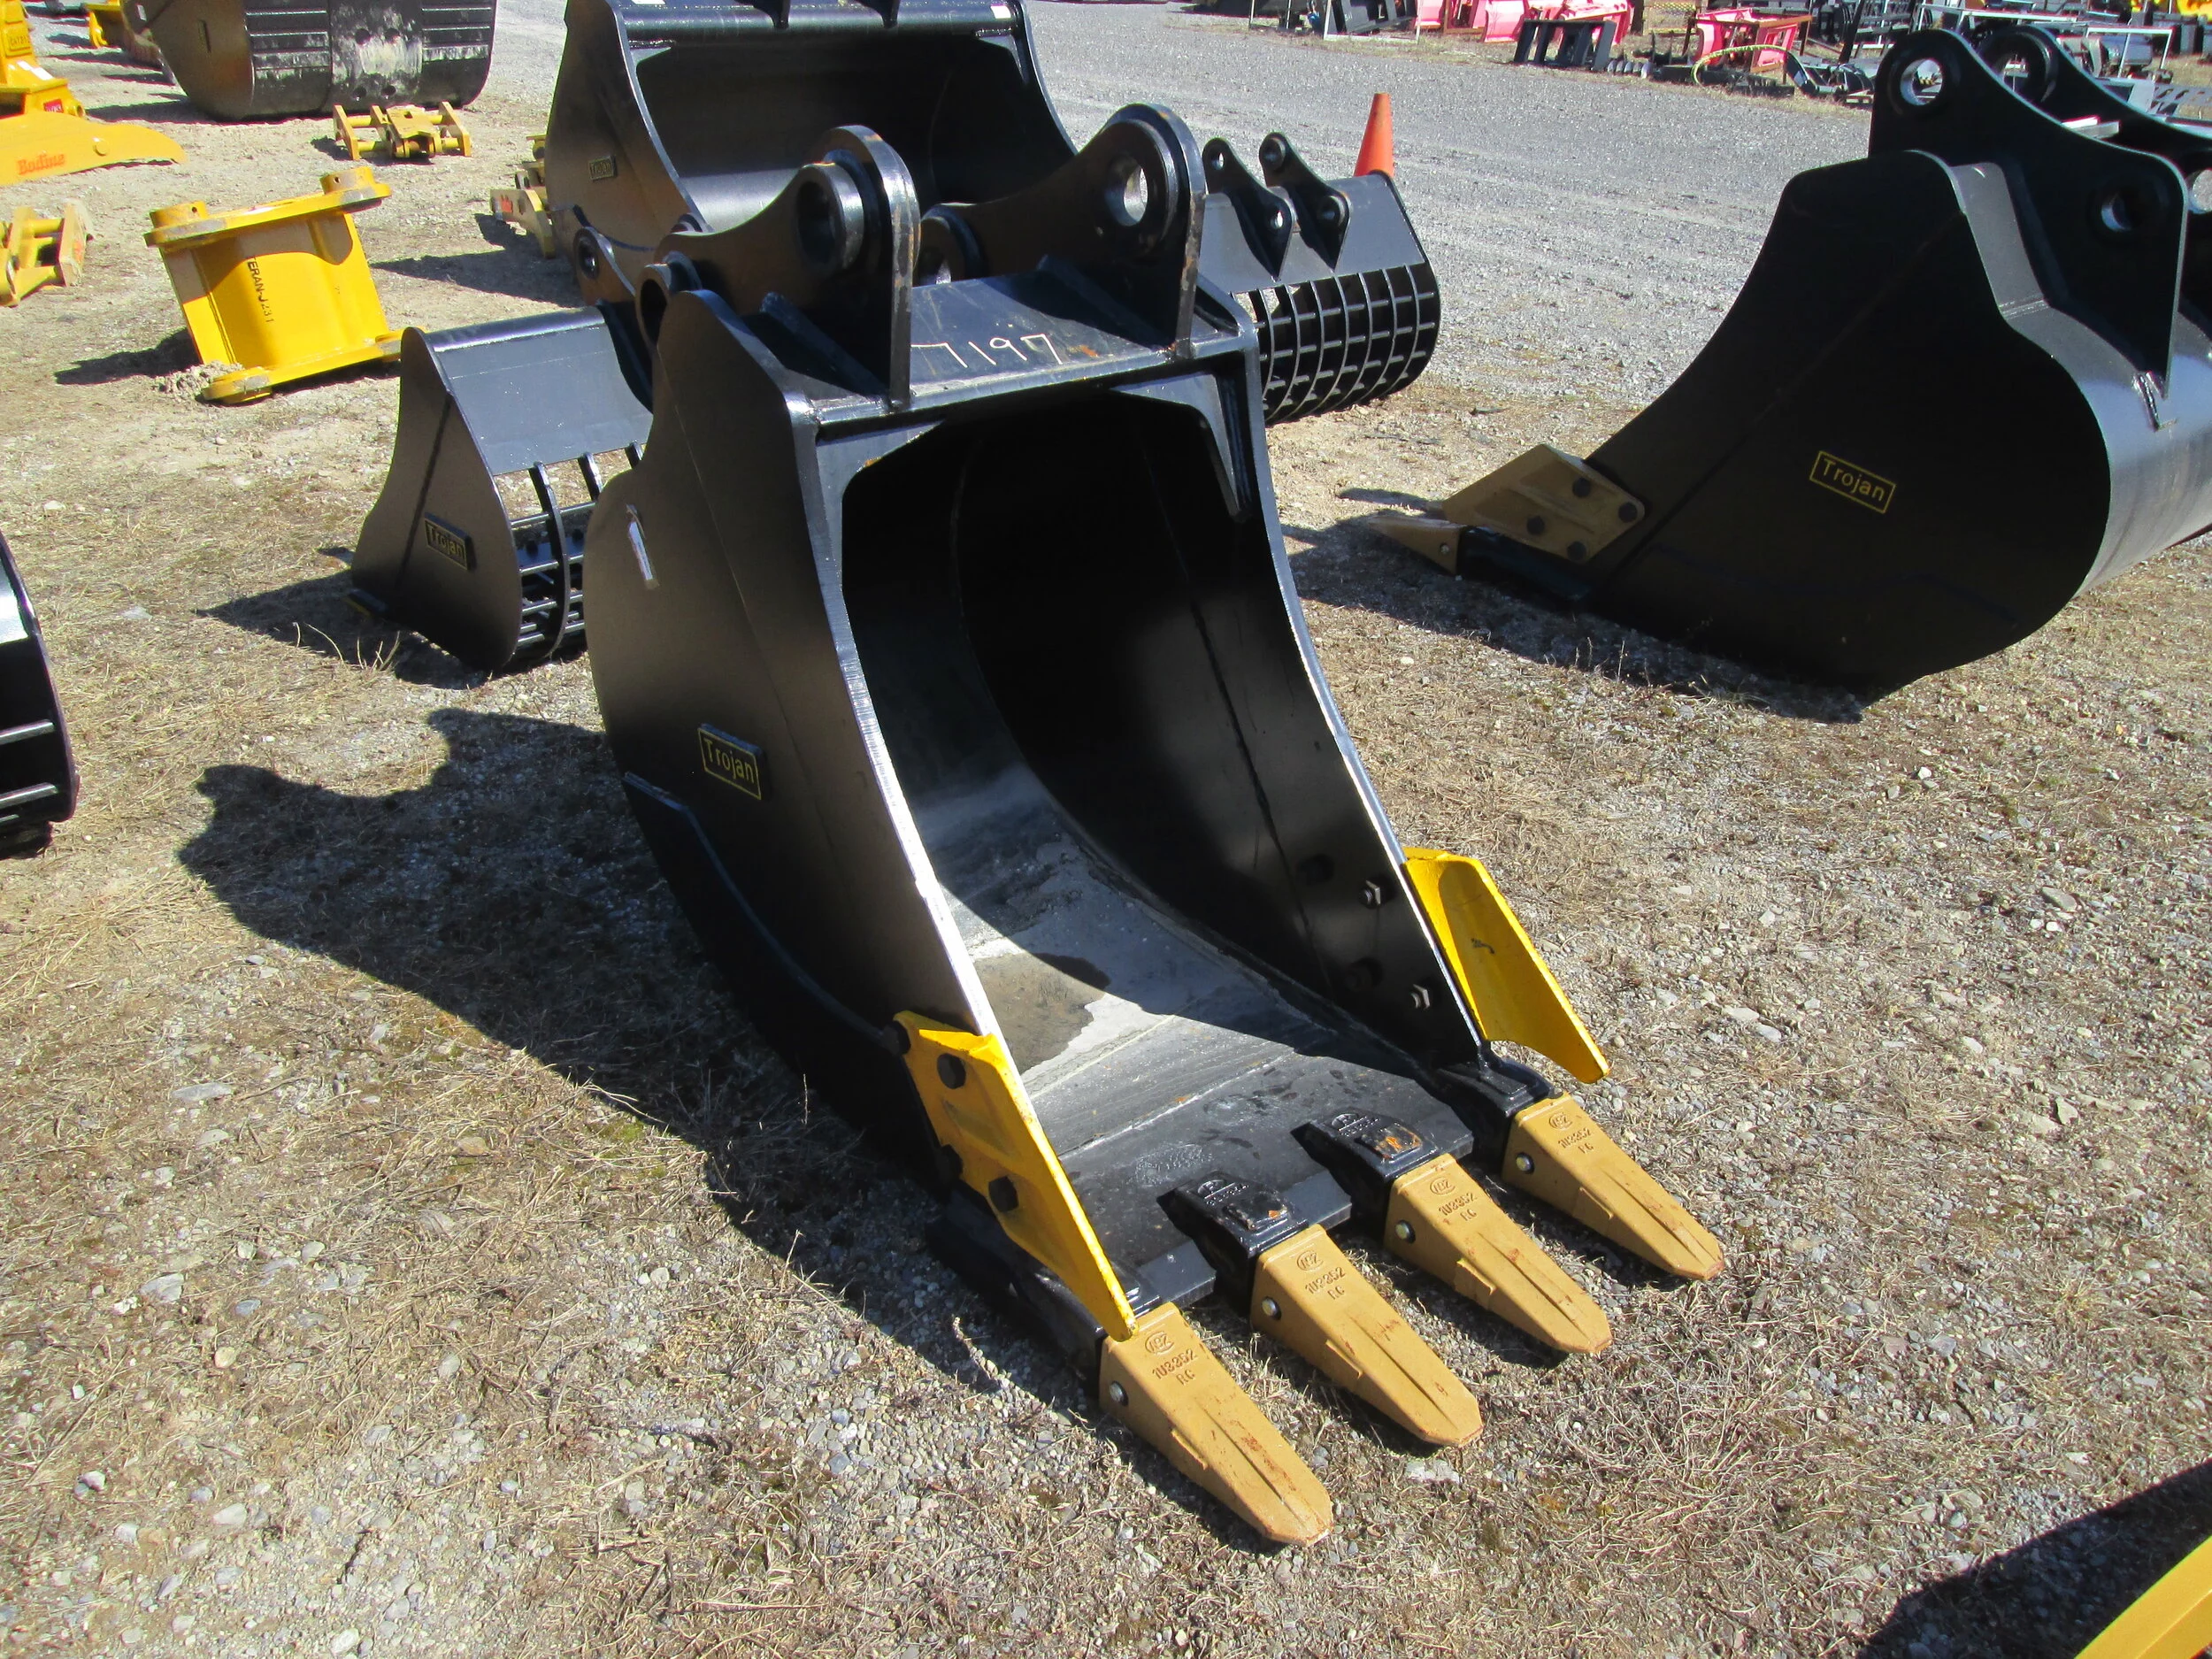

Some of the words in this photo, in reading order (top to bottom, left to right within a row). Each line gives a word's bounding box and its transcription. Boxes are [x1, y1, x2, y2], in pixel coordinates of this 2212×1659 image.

[910, 333, 1064, 368] 7197
[1823, 458, 1885, 502] Trojan
[426, 523, 465, 558] Trojan
[703, 737, 755, 784] Trojan
[1152, 1348, 1198, 1379] 1U3352
